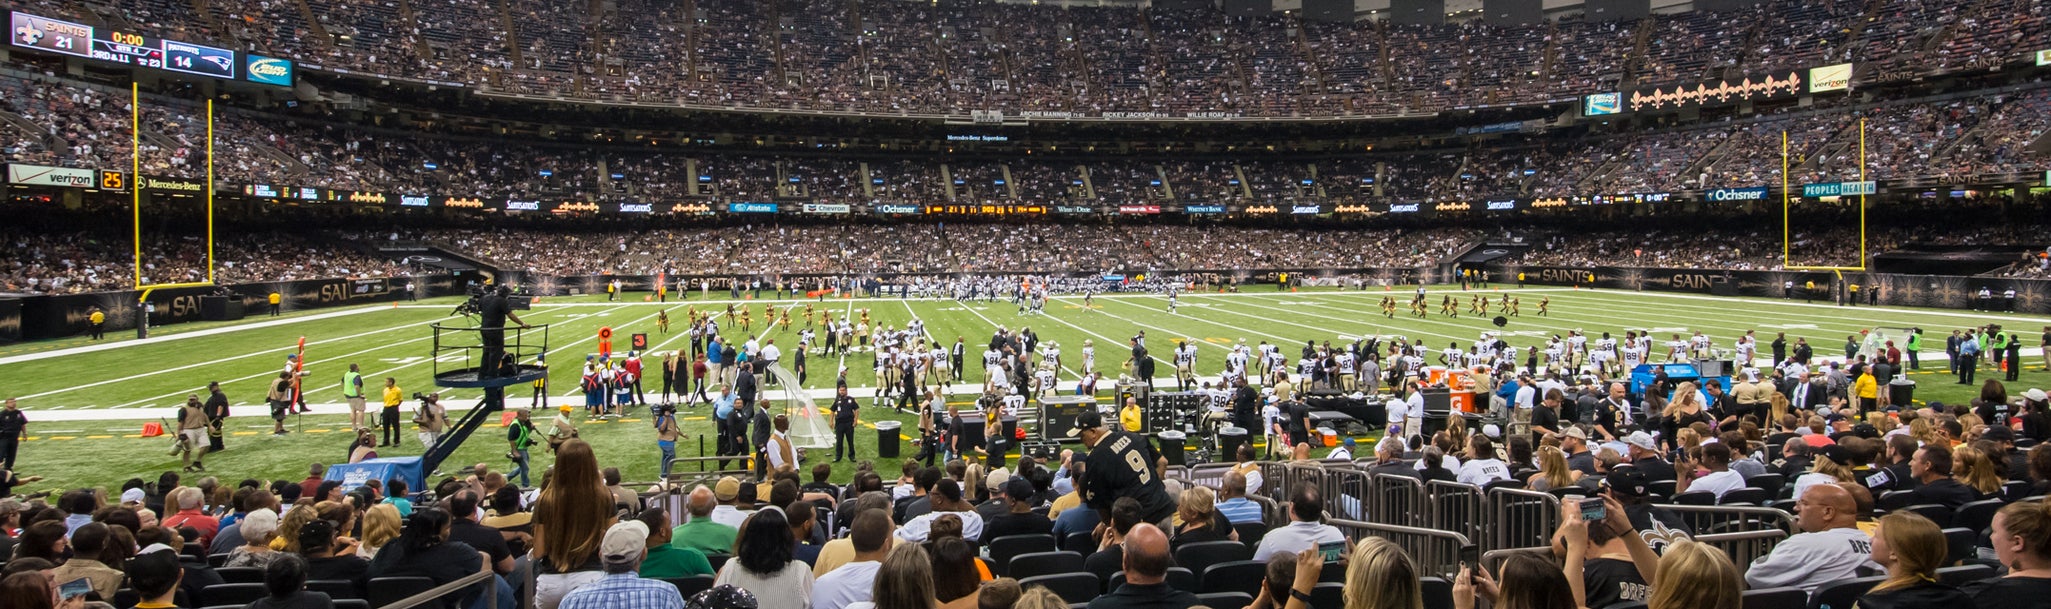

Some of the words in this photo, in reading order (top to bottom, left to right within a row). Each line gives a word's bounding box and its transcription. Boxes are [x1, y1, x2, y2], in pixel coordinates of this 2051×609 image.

[45, 22, 87, 37] SAINTS
[55, 35, 73, 49] 21
[112, 32, 144, 47] 0:00
[168, 43, 200, 55] PATRIOTS
[93, 50, 111, 61] 3RD
[118, 54, 130, 63] 11
[174, 56, 192, 68] 14
[148, 59, 161, 68] 23
[1814, 79, 1848, 89] verizon
[50, 173, 91, 187] verizon
[103, 172, 122, 188] 25
[148, 178, 202, 191] Mercedes-Benz
[1715, 188, 1762, 200] Ochsner
[1805, 184, 1840, 195] PEOPLES
[883, 204, 916, 214] Ochsner
[1543, 269, 1590, 284] SAINTS
[634, 335, 645, 347] 3
[936, 354, 946, 363] 92
[1449, 352, 1458, 362] 15
[1009, 399, 1021, 409] 47
[1213, 395, 1227, 408] 98
[1125, 449, 1151, 485] 9
[1481, 465, 1500, 475] BREES
